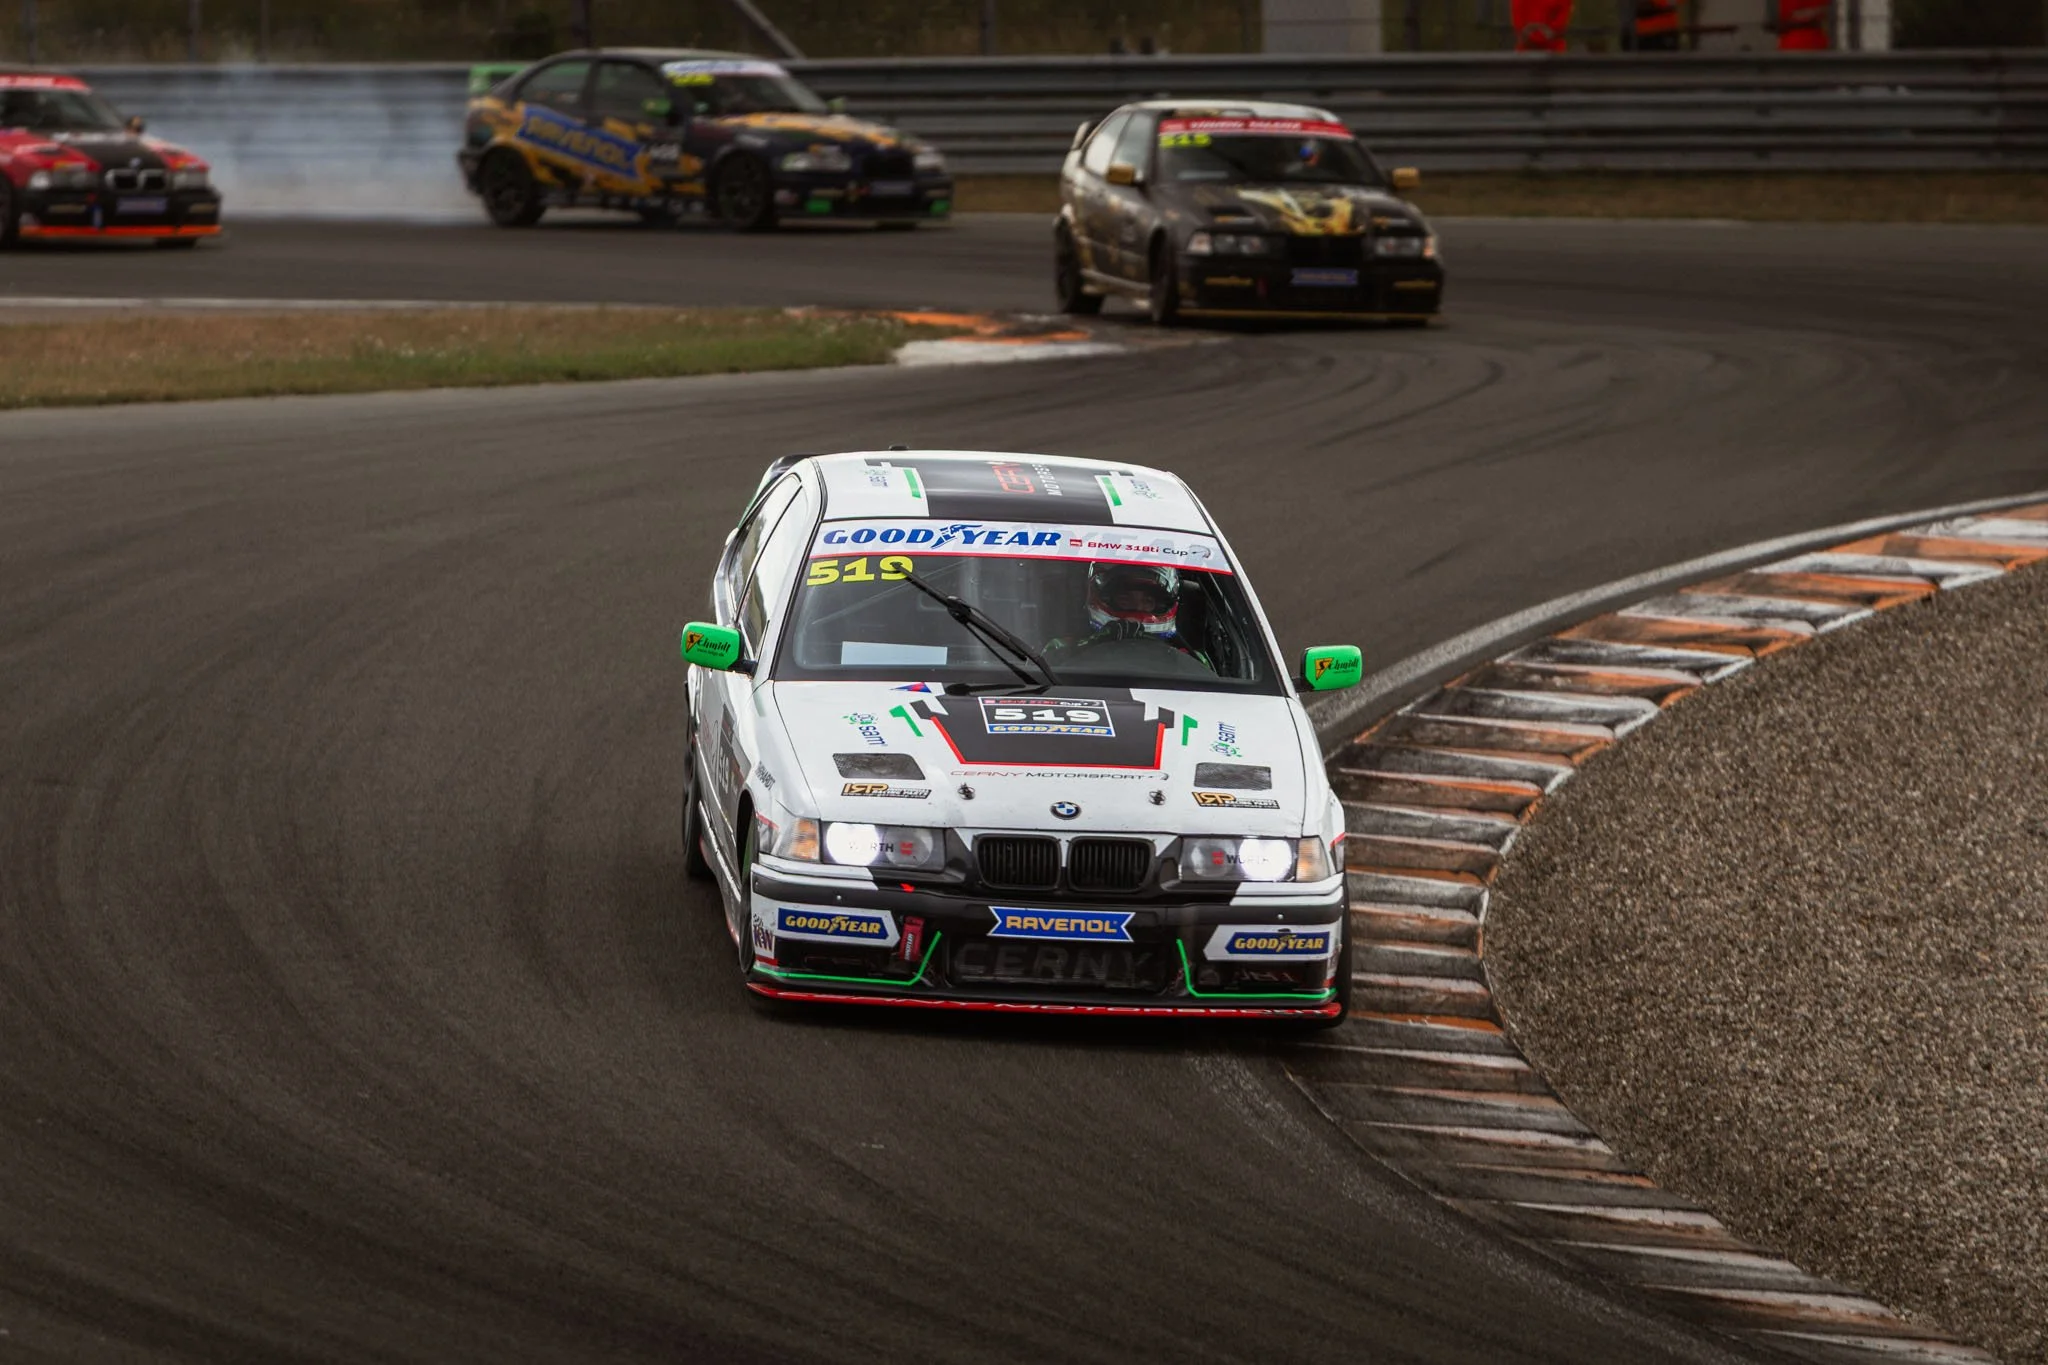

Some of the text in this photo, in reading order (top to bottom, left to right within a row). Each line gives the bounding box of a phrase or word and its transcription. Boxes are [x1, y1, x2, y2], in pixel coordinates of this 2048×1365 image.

[1124, 544, 1159, 553] 318ti
[1162, 547, 1188, 557] Cup
[806, 556, 914, 586] 519
[994, 708, 1100, 723] 519
[993, 725, 1107, 735] GOODYEAR
[1026, 772, 1145, 780] MOTORSPORT
[785, 915, 881, 934] GOODYEAR
[1006, 915, 1118, 933] RAVENOL
[1234, 937, 1324, 951] GOODYEAR
[954, 943, 1153, 984] CERNY
